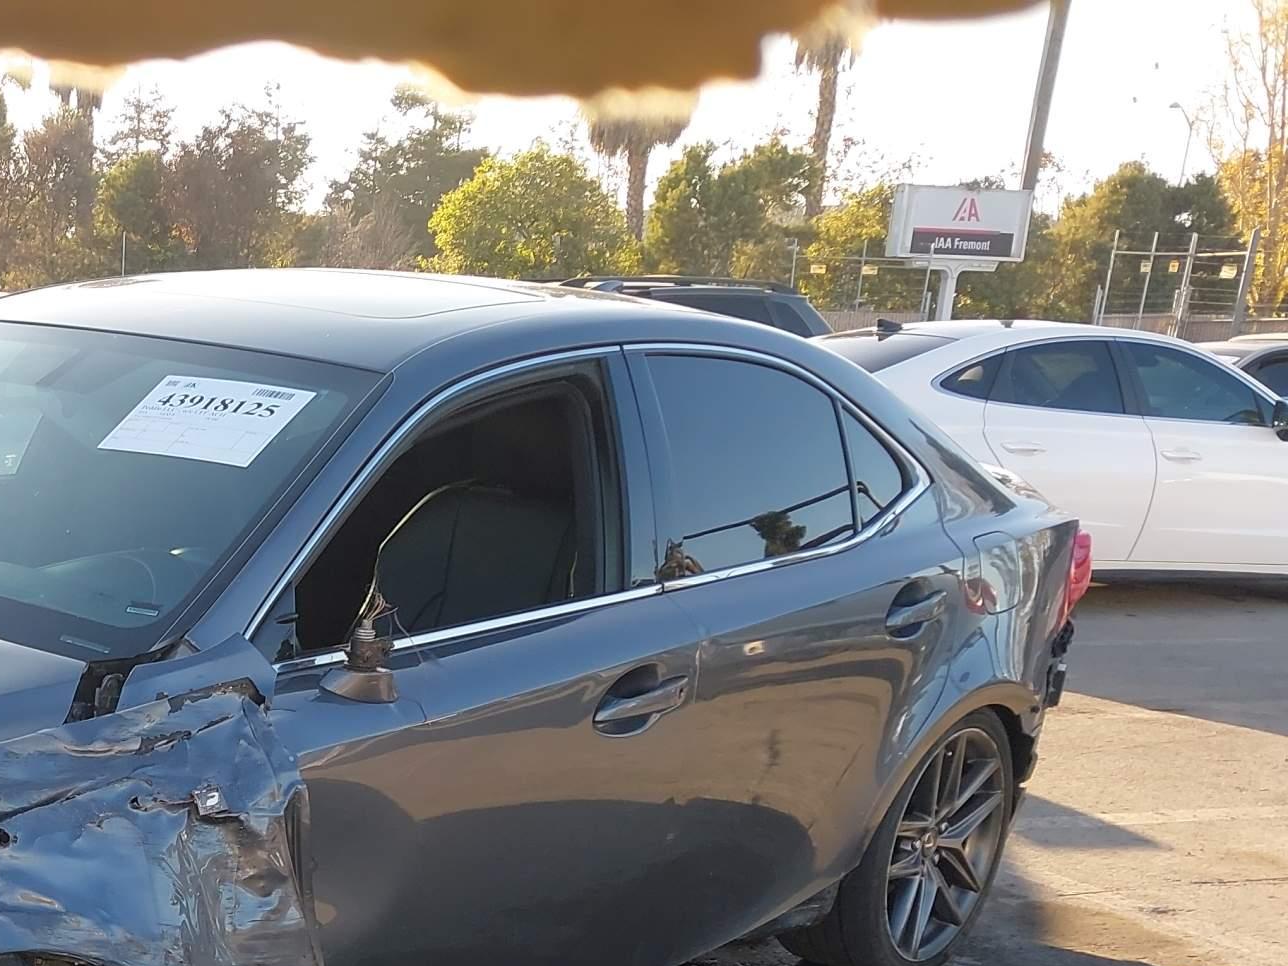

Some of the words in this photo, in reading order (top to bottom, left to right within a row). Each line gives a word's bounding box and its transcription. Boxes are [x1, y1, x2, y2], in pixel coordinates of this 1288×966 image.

[934, 236, 952, 249] IAA
[953, 237, 991, 251] Fremont
[157, 392, 281, 418] 43918125
